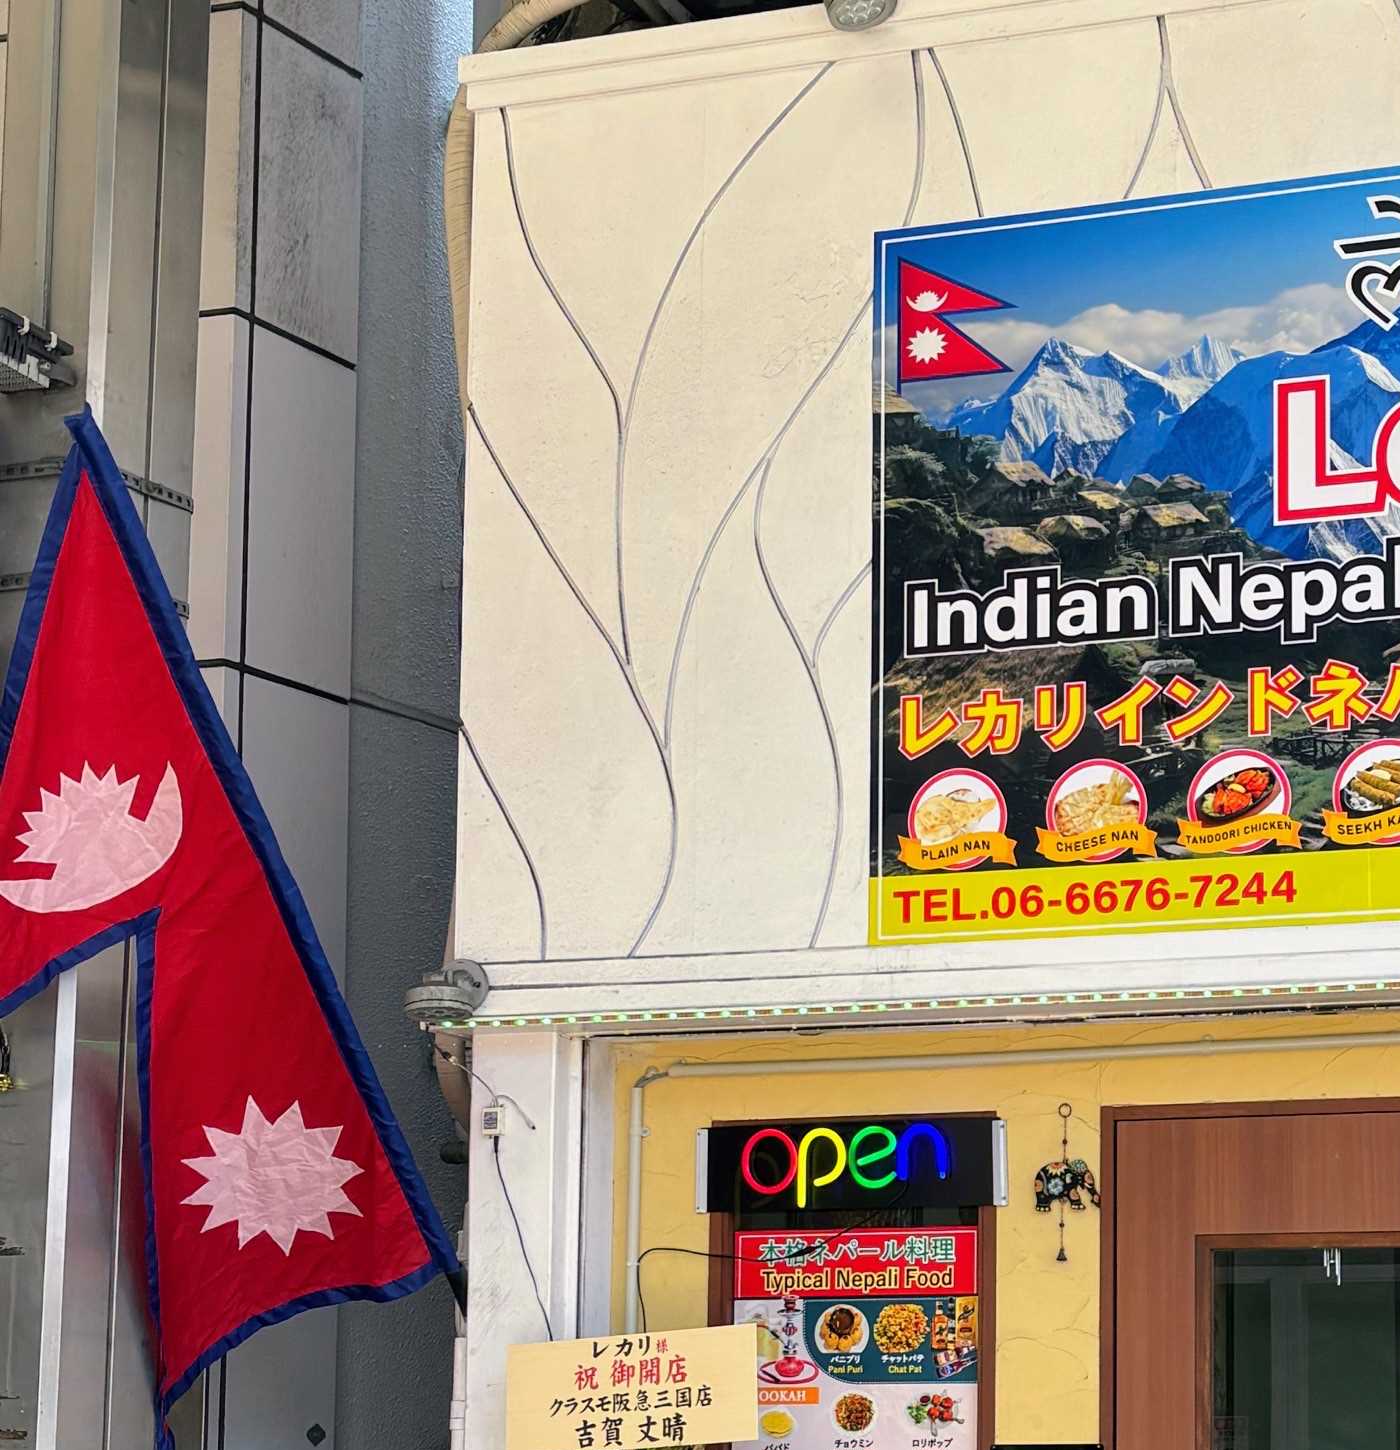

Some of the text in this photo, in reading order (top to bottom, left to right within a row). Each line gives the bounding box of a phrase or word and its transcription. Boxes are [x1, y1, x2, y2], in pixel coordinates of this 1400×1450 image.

[910, 572, 1152, 650] Indian
[1055, 828, 1140, 853] CHEESE NAN
[1185, 820, 1293, 846] TANDOORI CHICKEN
[1336, 818, 1383, 838] SEEKH
[920, 839, 992, 861] PLAIN NAN
[893, 869, 1297, 925] TEL.06-6676-7244
[762, 1267, 954, 1293] Typical Nepali Food
[573, 1354, 689, 1391] 祝 御開店
[549, 1384, 714, 1418] クラスモ阪急三国店
